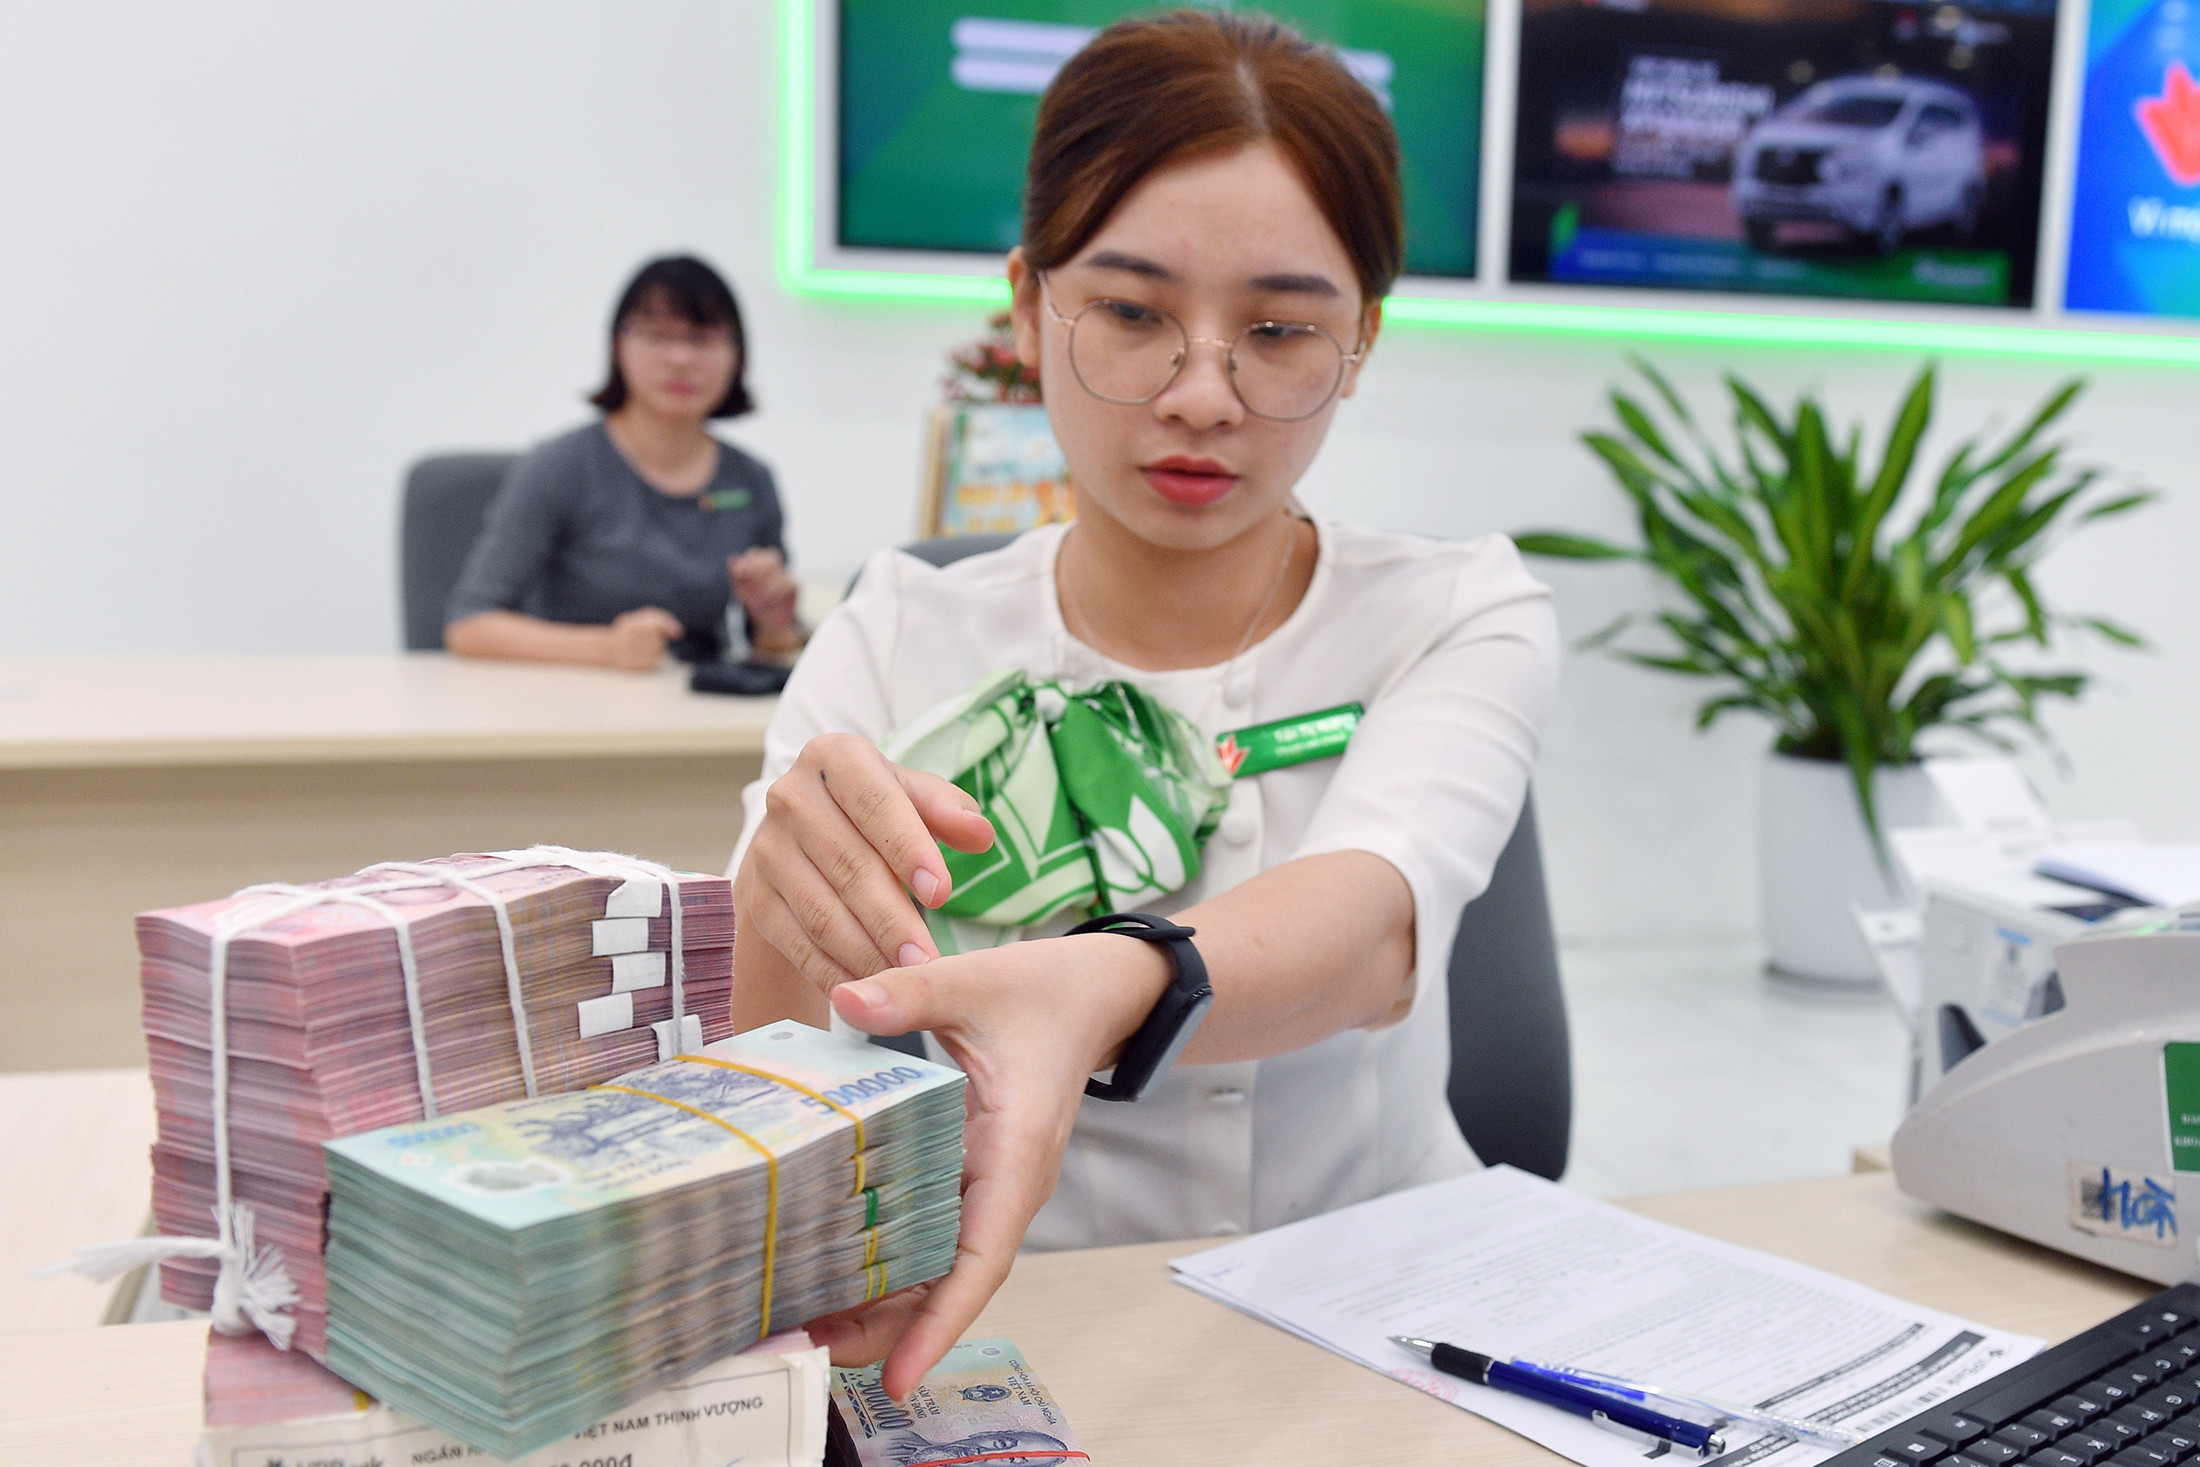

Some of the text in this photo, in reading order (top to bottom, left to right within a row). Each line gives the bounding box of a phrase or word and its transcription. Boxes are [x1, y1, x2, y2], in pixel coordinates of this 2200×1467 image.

[801, 1066, 922, 1116] 500000
[2180, 1346, 2196, 1357] X
[2155, 1359, 2171, 1369] C
[2131, 1373, 2148, 1383] V
[1007, 1376, 1032, 1406] VIỆT NAM
[2106, 1386, 2122, 1397] B
[2166, 1395, 2183, 1405] G
[924, 1398, 940, 1416] TRĂM
[2079, 1400, 2096, 1412] N
[2141, 1409, 2159, 1421] H
[2051, 1415, 2069, 1427] M
[411, 1446, 464, 1465] NGÂN
[575, 1422, 608, 1440] IỆT
[612, 1416, 649, 1434] NAM
[654, 1409, 700, 1427] THỊNH
[703, 1397, 764, 1418] VƯỢNG
[2116, 1424, 2130, 1435] J
[2087, 1439, 2105, 1450] K
[2172, 1437, 2189, 1447] U
[2060, 1450, 2077, 1463] L
